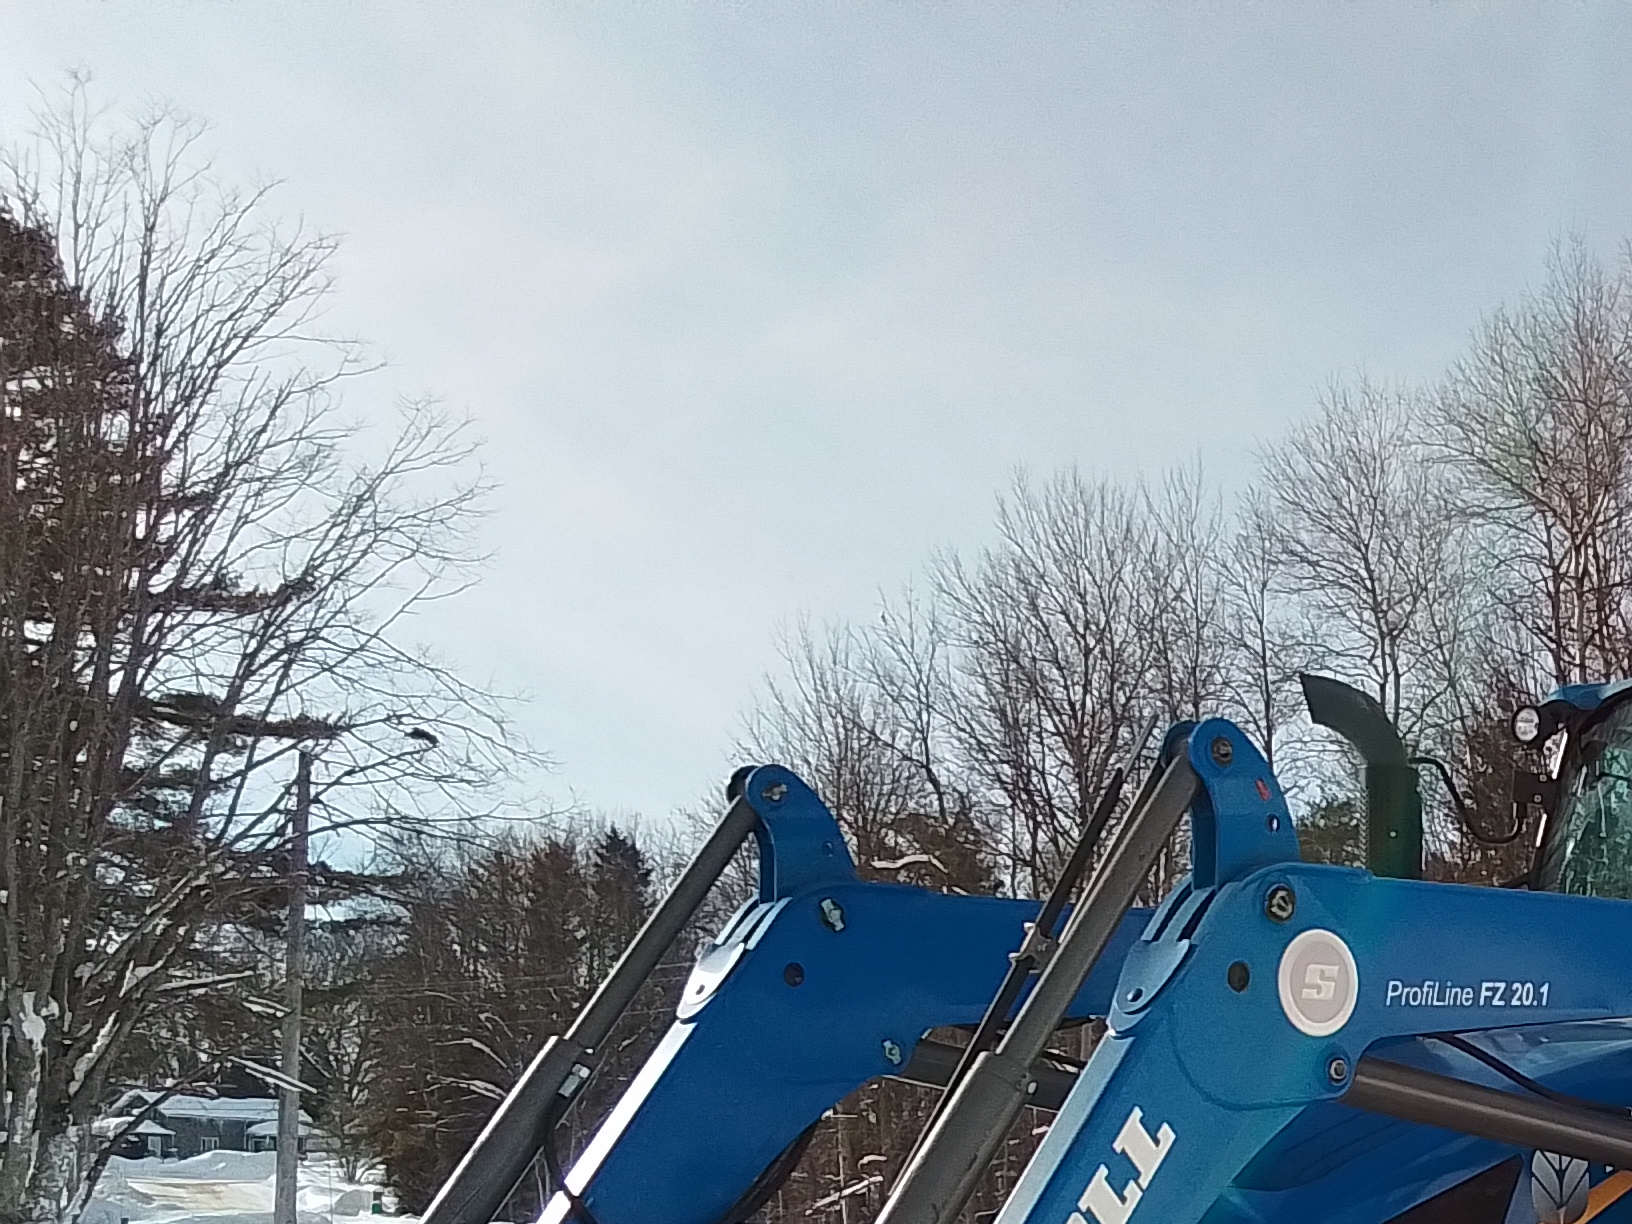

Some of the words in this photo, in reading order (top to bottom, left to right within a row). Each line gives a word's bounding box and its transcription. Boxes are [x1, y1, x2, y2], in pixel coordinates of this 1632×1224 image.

[1302, 963, 1339, 1000] S
[1385, 980, 1474, 1007] ProfiLine
[1479, 981, 1506, 1007] FZ
[1511, 981, 1550, 1007] 20.1
